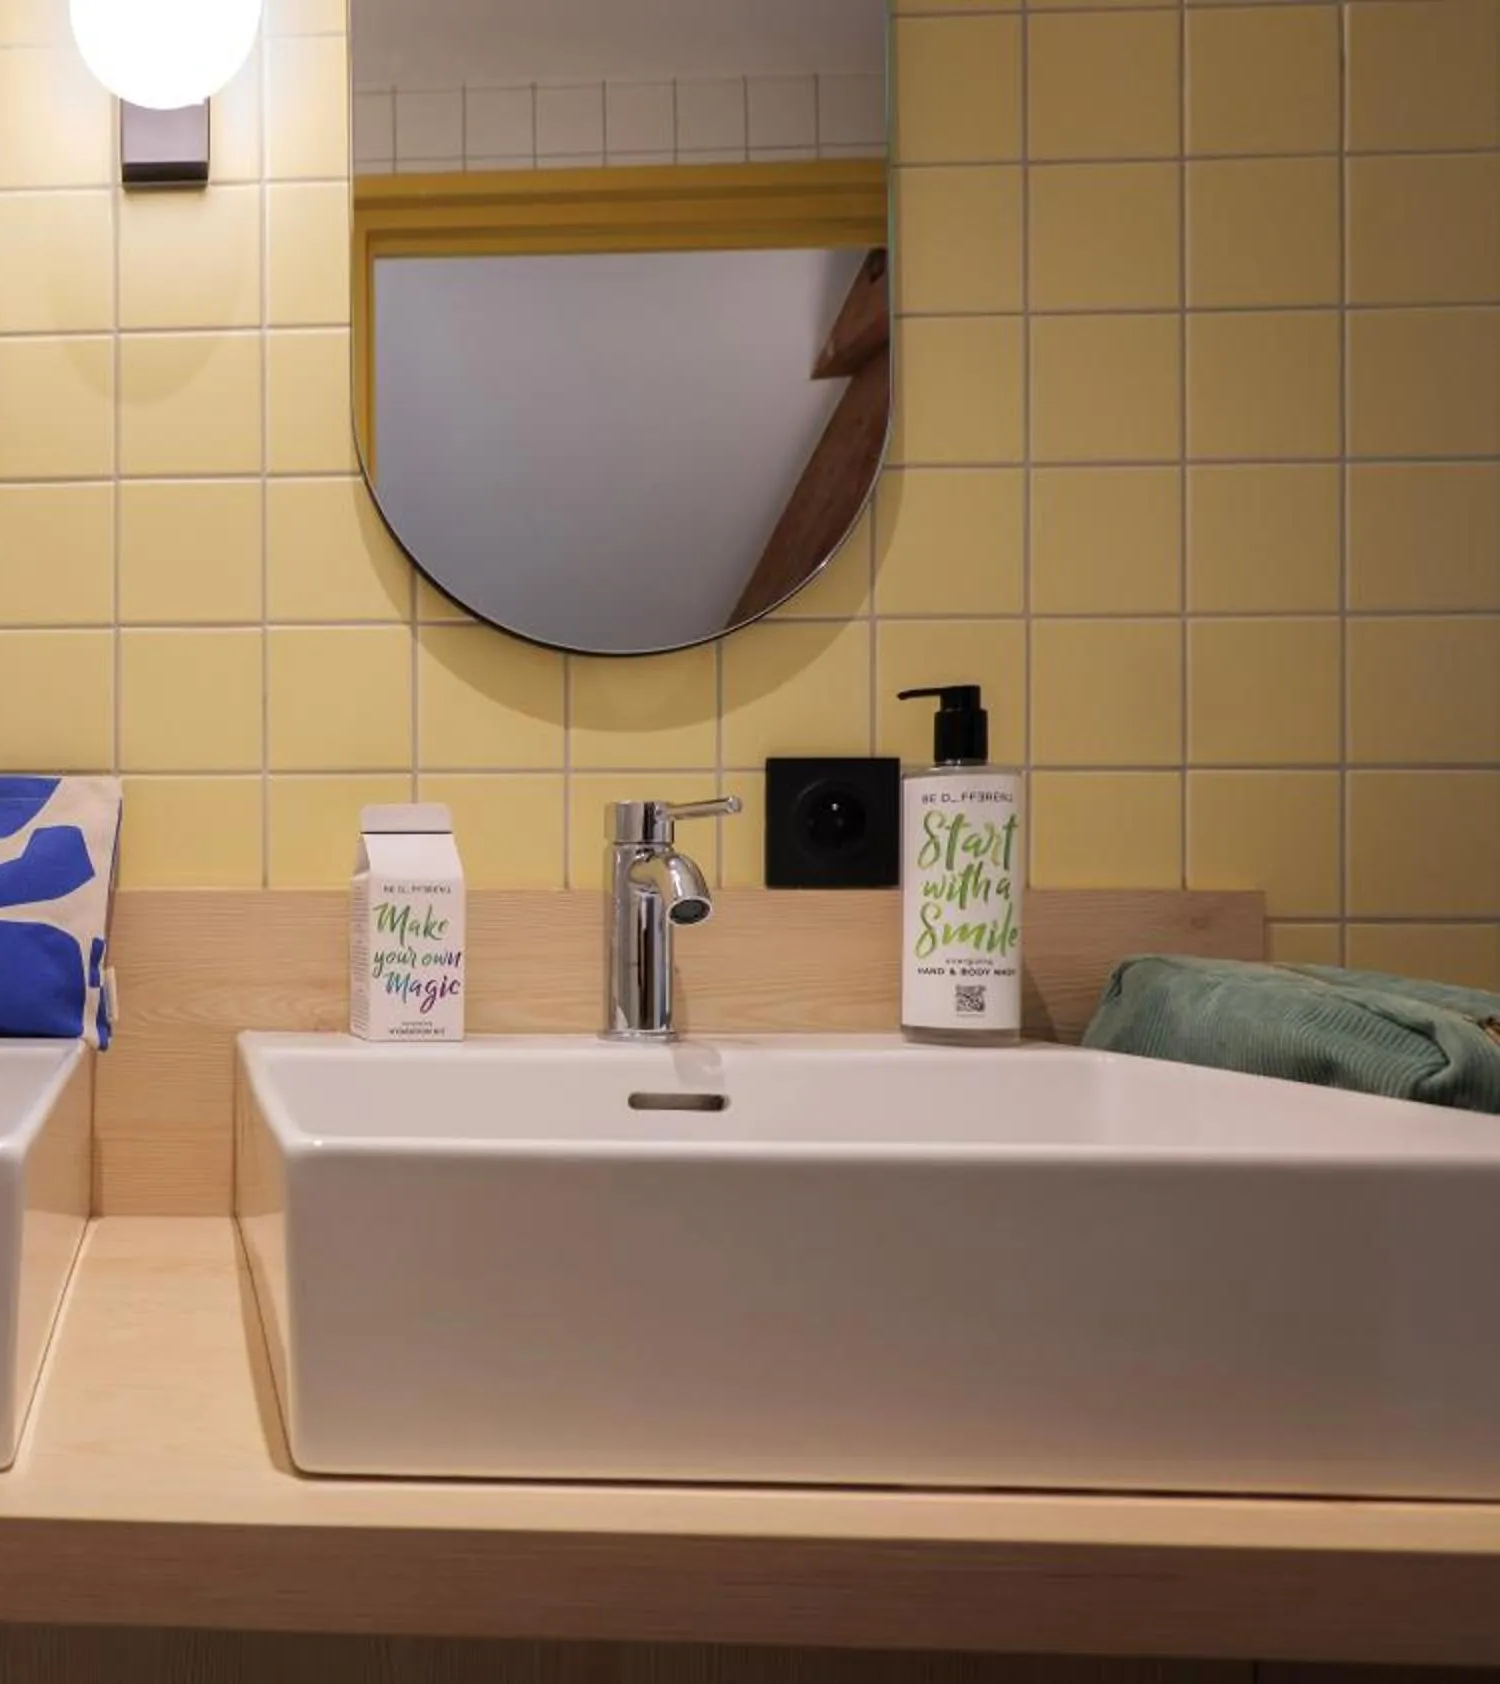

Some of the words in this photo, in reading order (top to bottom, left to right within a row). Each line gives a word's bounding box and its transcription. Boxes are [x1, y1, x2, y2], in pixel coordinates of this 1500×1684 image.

[917, 809, 1019, 871] Start
[923, 860, 991, 910] with
[995, 877, 1011, 900] a
[372, 902, 451, 947] Make
[914, 901, 1018, 959] Smile
[372, 946, 417, 979] your
[421, 950, 462, 968] own
[917, 967, 945, 976] HAND
[949, 967, 957, 976] &
[961, 967, 990, 977] BODY
[384, 971, 461, 1014] Magic
